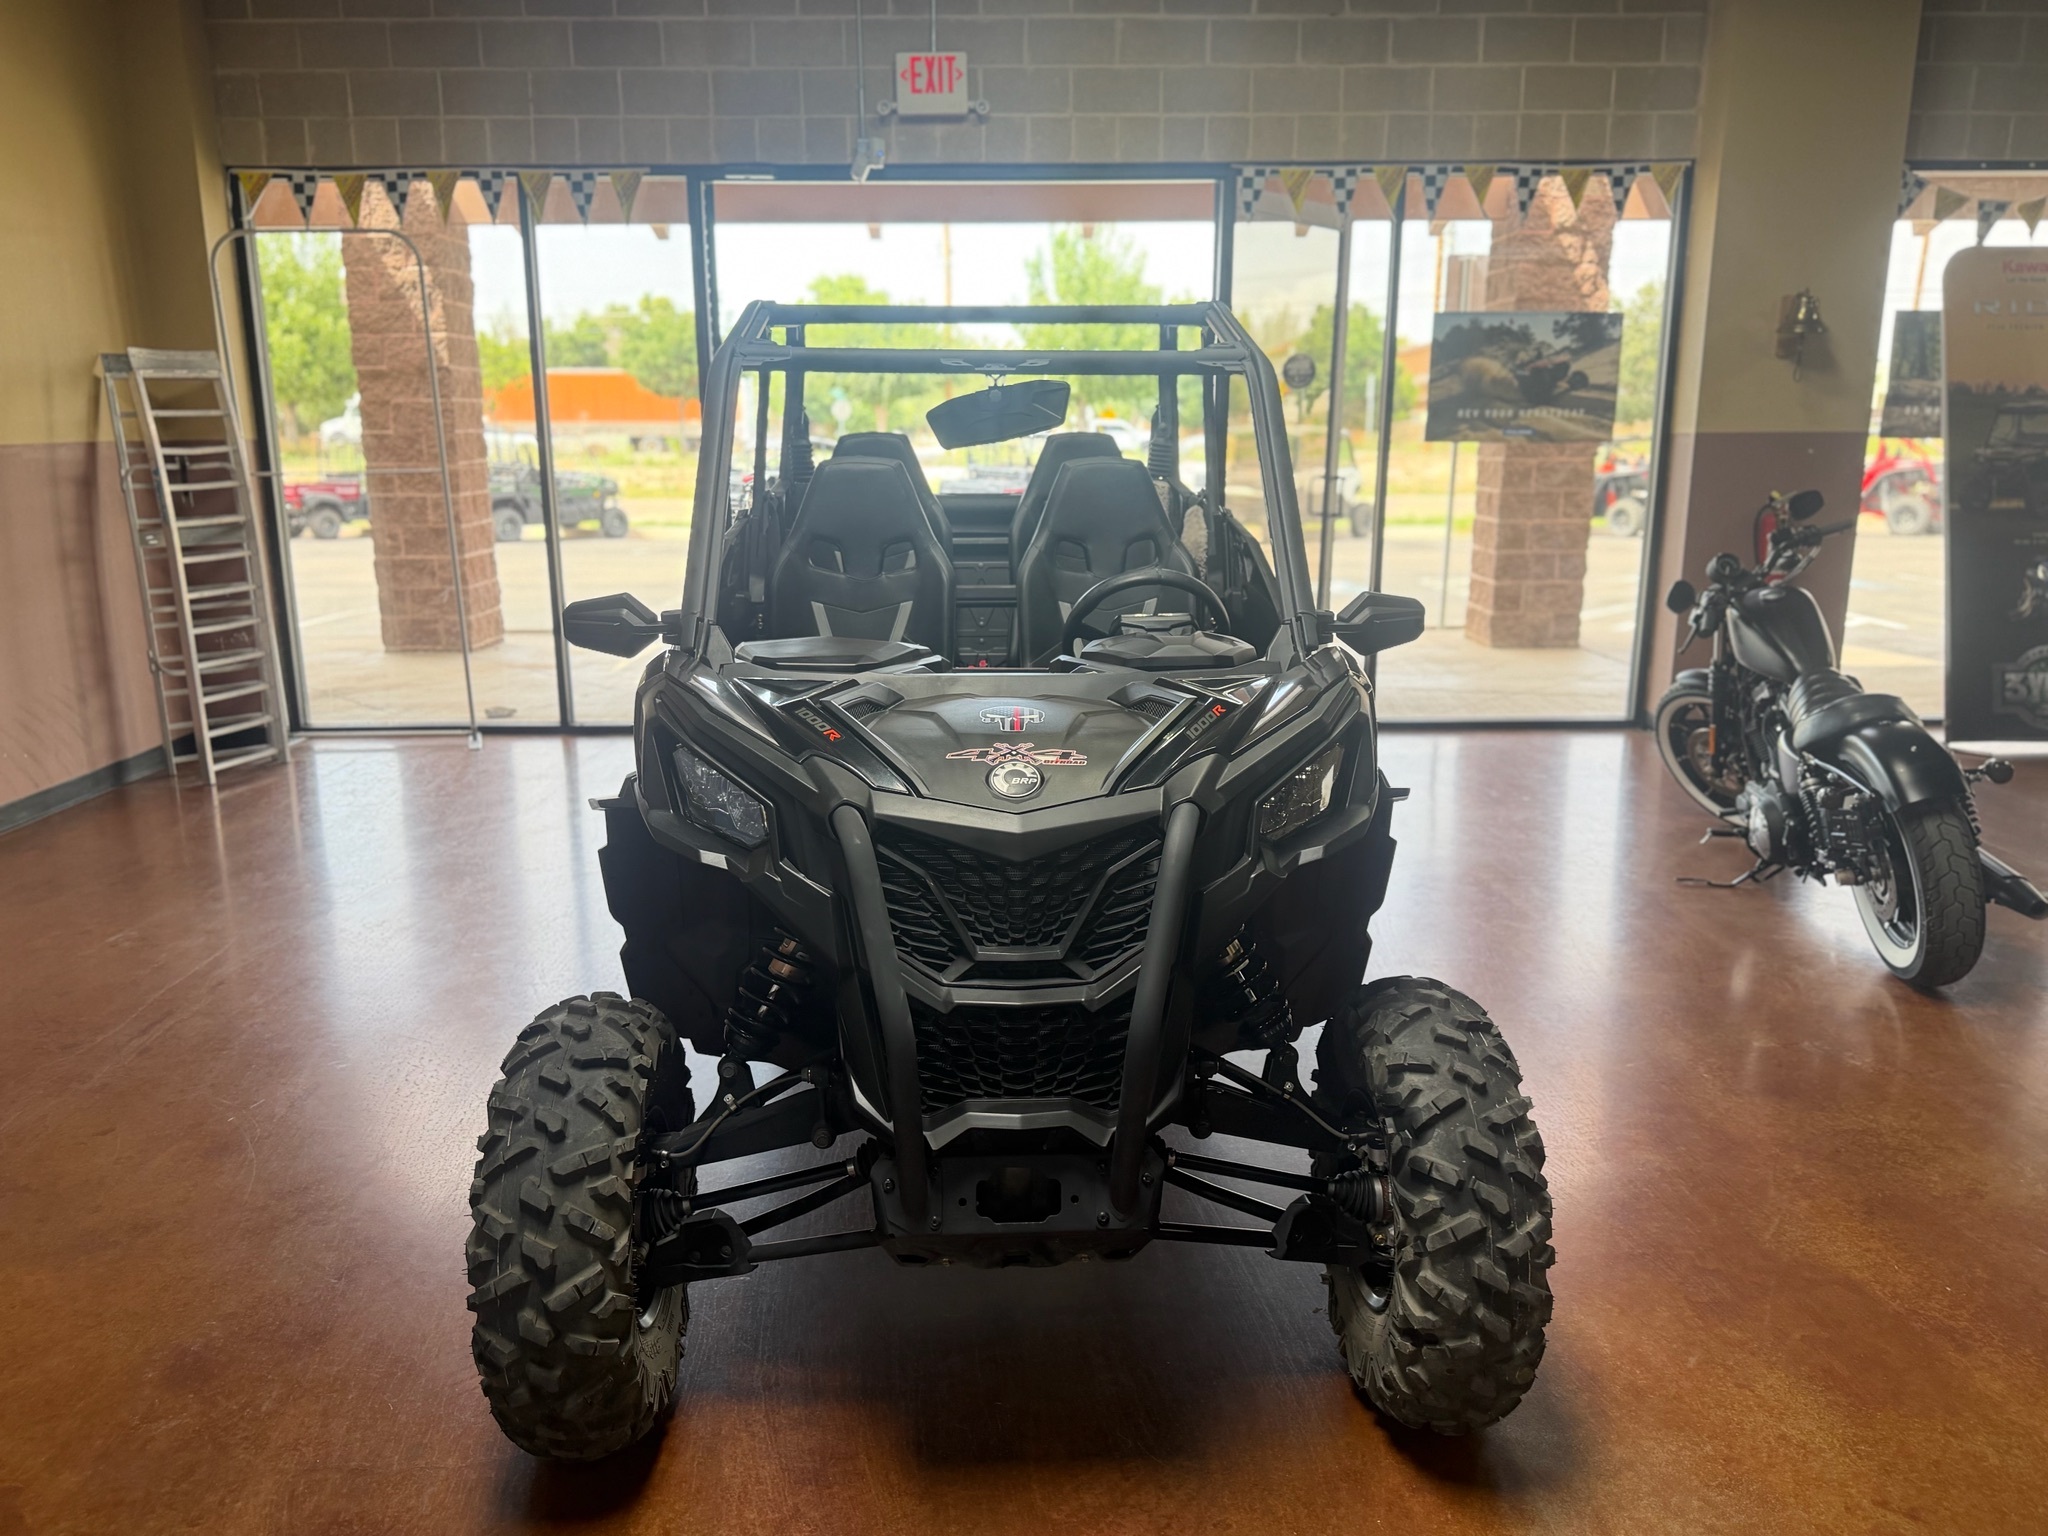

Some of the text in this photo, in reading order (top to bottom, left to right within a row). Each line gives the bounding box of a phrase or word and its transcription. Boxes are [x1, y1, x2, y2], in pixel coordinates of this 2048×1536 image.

[909, 55, 956, 94] EXIT
[795, 707, 841, 742] 1000R
[1185, 704, 1227, 740] 1000R
[1011, 777, 1037, 785] BRP
